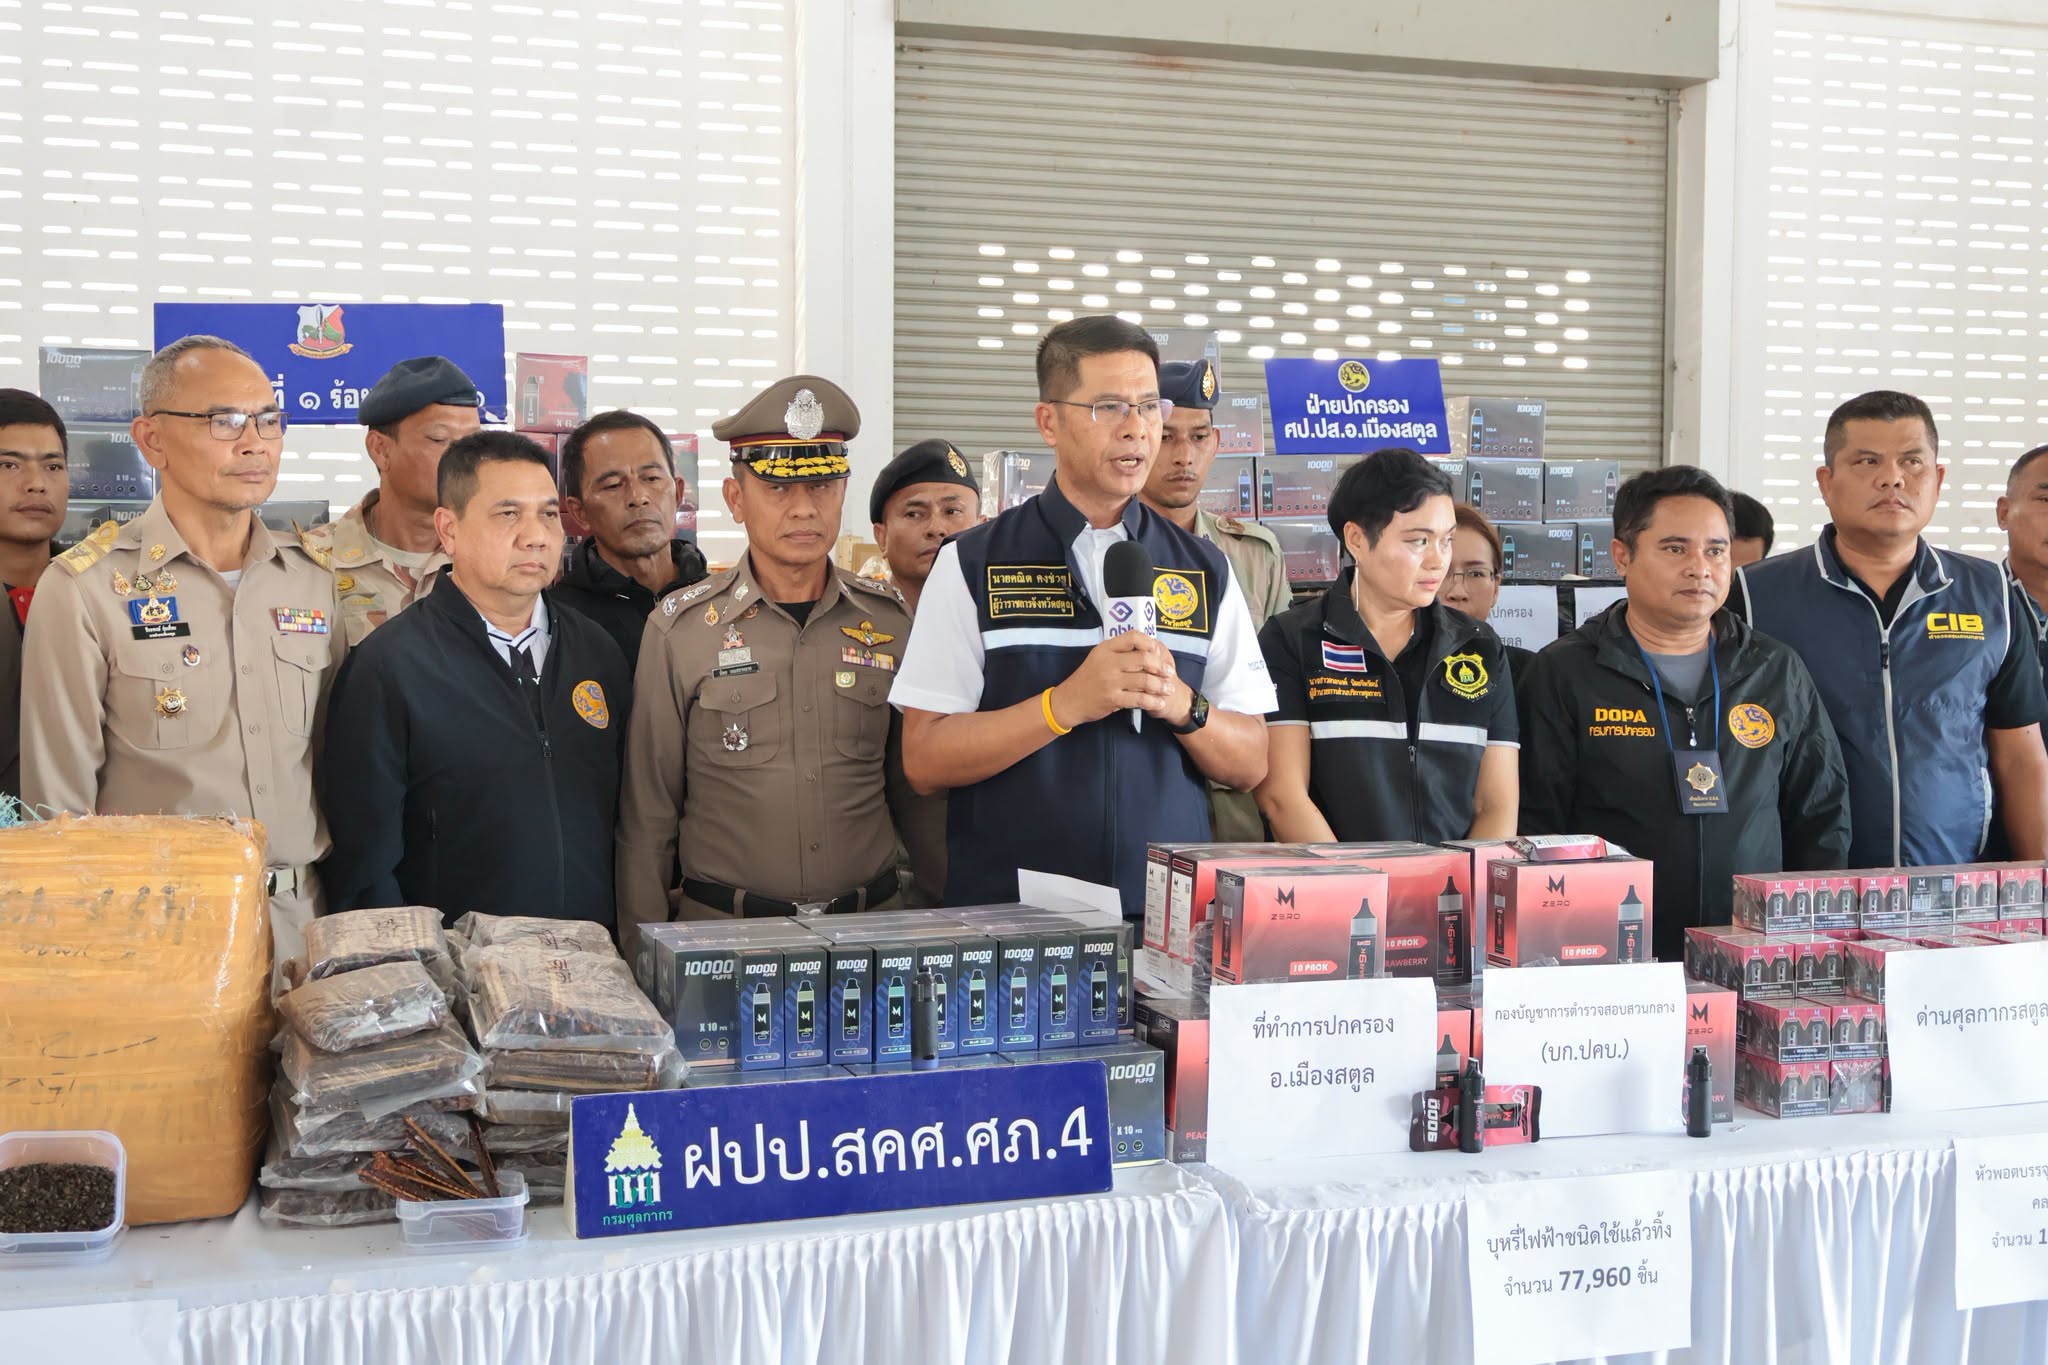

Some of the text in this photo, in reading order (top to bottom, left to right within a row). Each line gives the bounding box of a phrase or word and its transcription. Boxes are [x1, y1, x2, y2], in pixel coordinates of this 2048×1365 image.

[47, 352, 82, 364] 10000
[299, 391, 321, 411] ๑
[1232, 397, 1258, 407] 10000
[1306, 392, 1409, 415] ฝ่ายปกครอง
[1517, 404, 1543, 414] 10000
[1284, 417, 1438, 446] ศป.ปส.อ.เมืองสตูล
[1307, 460, 1333, 469] 10000
[1549, 466, 1574, 475] 10000
[1516, 467, 1541, 476] 10000
[1548, 529, 1573, 538] 10000
[992, 571, 1033, 584] นายคณิต
[1927, 612, 1984, 632] CIB
[1595, 708, 1647, 723] DOPA
[1589, 725, 1656, 737] กรมการปกครอง
[1084, 942, 1114, 953] 10000
[1396, 938, 1419, 947] PACK
[963, 950, 992, 961] 10000
[1004, 948, 1034, 959] 10000
[1044, 946, 1074, 956] 10000
[1575, 948, 1598, 956] PACK
[836, 959, 868, 970] 10000
[882, 957, 912, 968] 10000
[923, 954, 953, 966] 10000
[684, 960, 735, 977] 10000
[745, 963, 778, 974] 10000
[790, 961, 821, 972] 10000
[1294, 963, 1328, 972] 10 PACK
[1495, 1000, 1676, 1024] กองบัญชาการตำรวจสอบสวนกลาง
[1916, 1002, 2048, 1032] ด่านศุลกากรสตูล
[707, 1022, 718, 1032] 10
[1252, 1009, 1395, 1040] ที่ทำการปกครอง
[1687, 1027, 1714, 1035] ZERO
[1541, 1038, 1631, 1064] (บก.ปคบ.)
[1109, 1063, 1156, 1080] 10000
[1269, 1060, 1376, 1094] อ.เมืองสตูล
[1427, 1098, 1438, 1143] 9000
[1124, 1125, 1134, 1135] 10
[683, 1105, 1093, 1190] ฝปป.สคศ.ศภ.4
[602, 1210, 673, 1229] กรมศุลกากร
[1486, 1210, 1672, 1260] บุหรี่ไฟฟ้าชนิดใช้แล้วทิ้ง
[1992, 1231, 2032, 1248] จำนวน
[1503, 1258, 1659, 1297] จำนวน 77,960 ชิ้น
